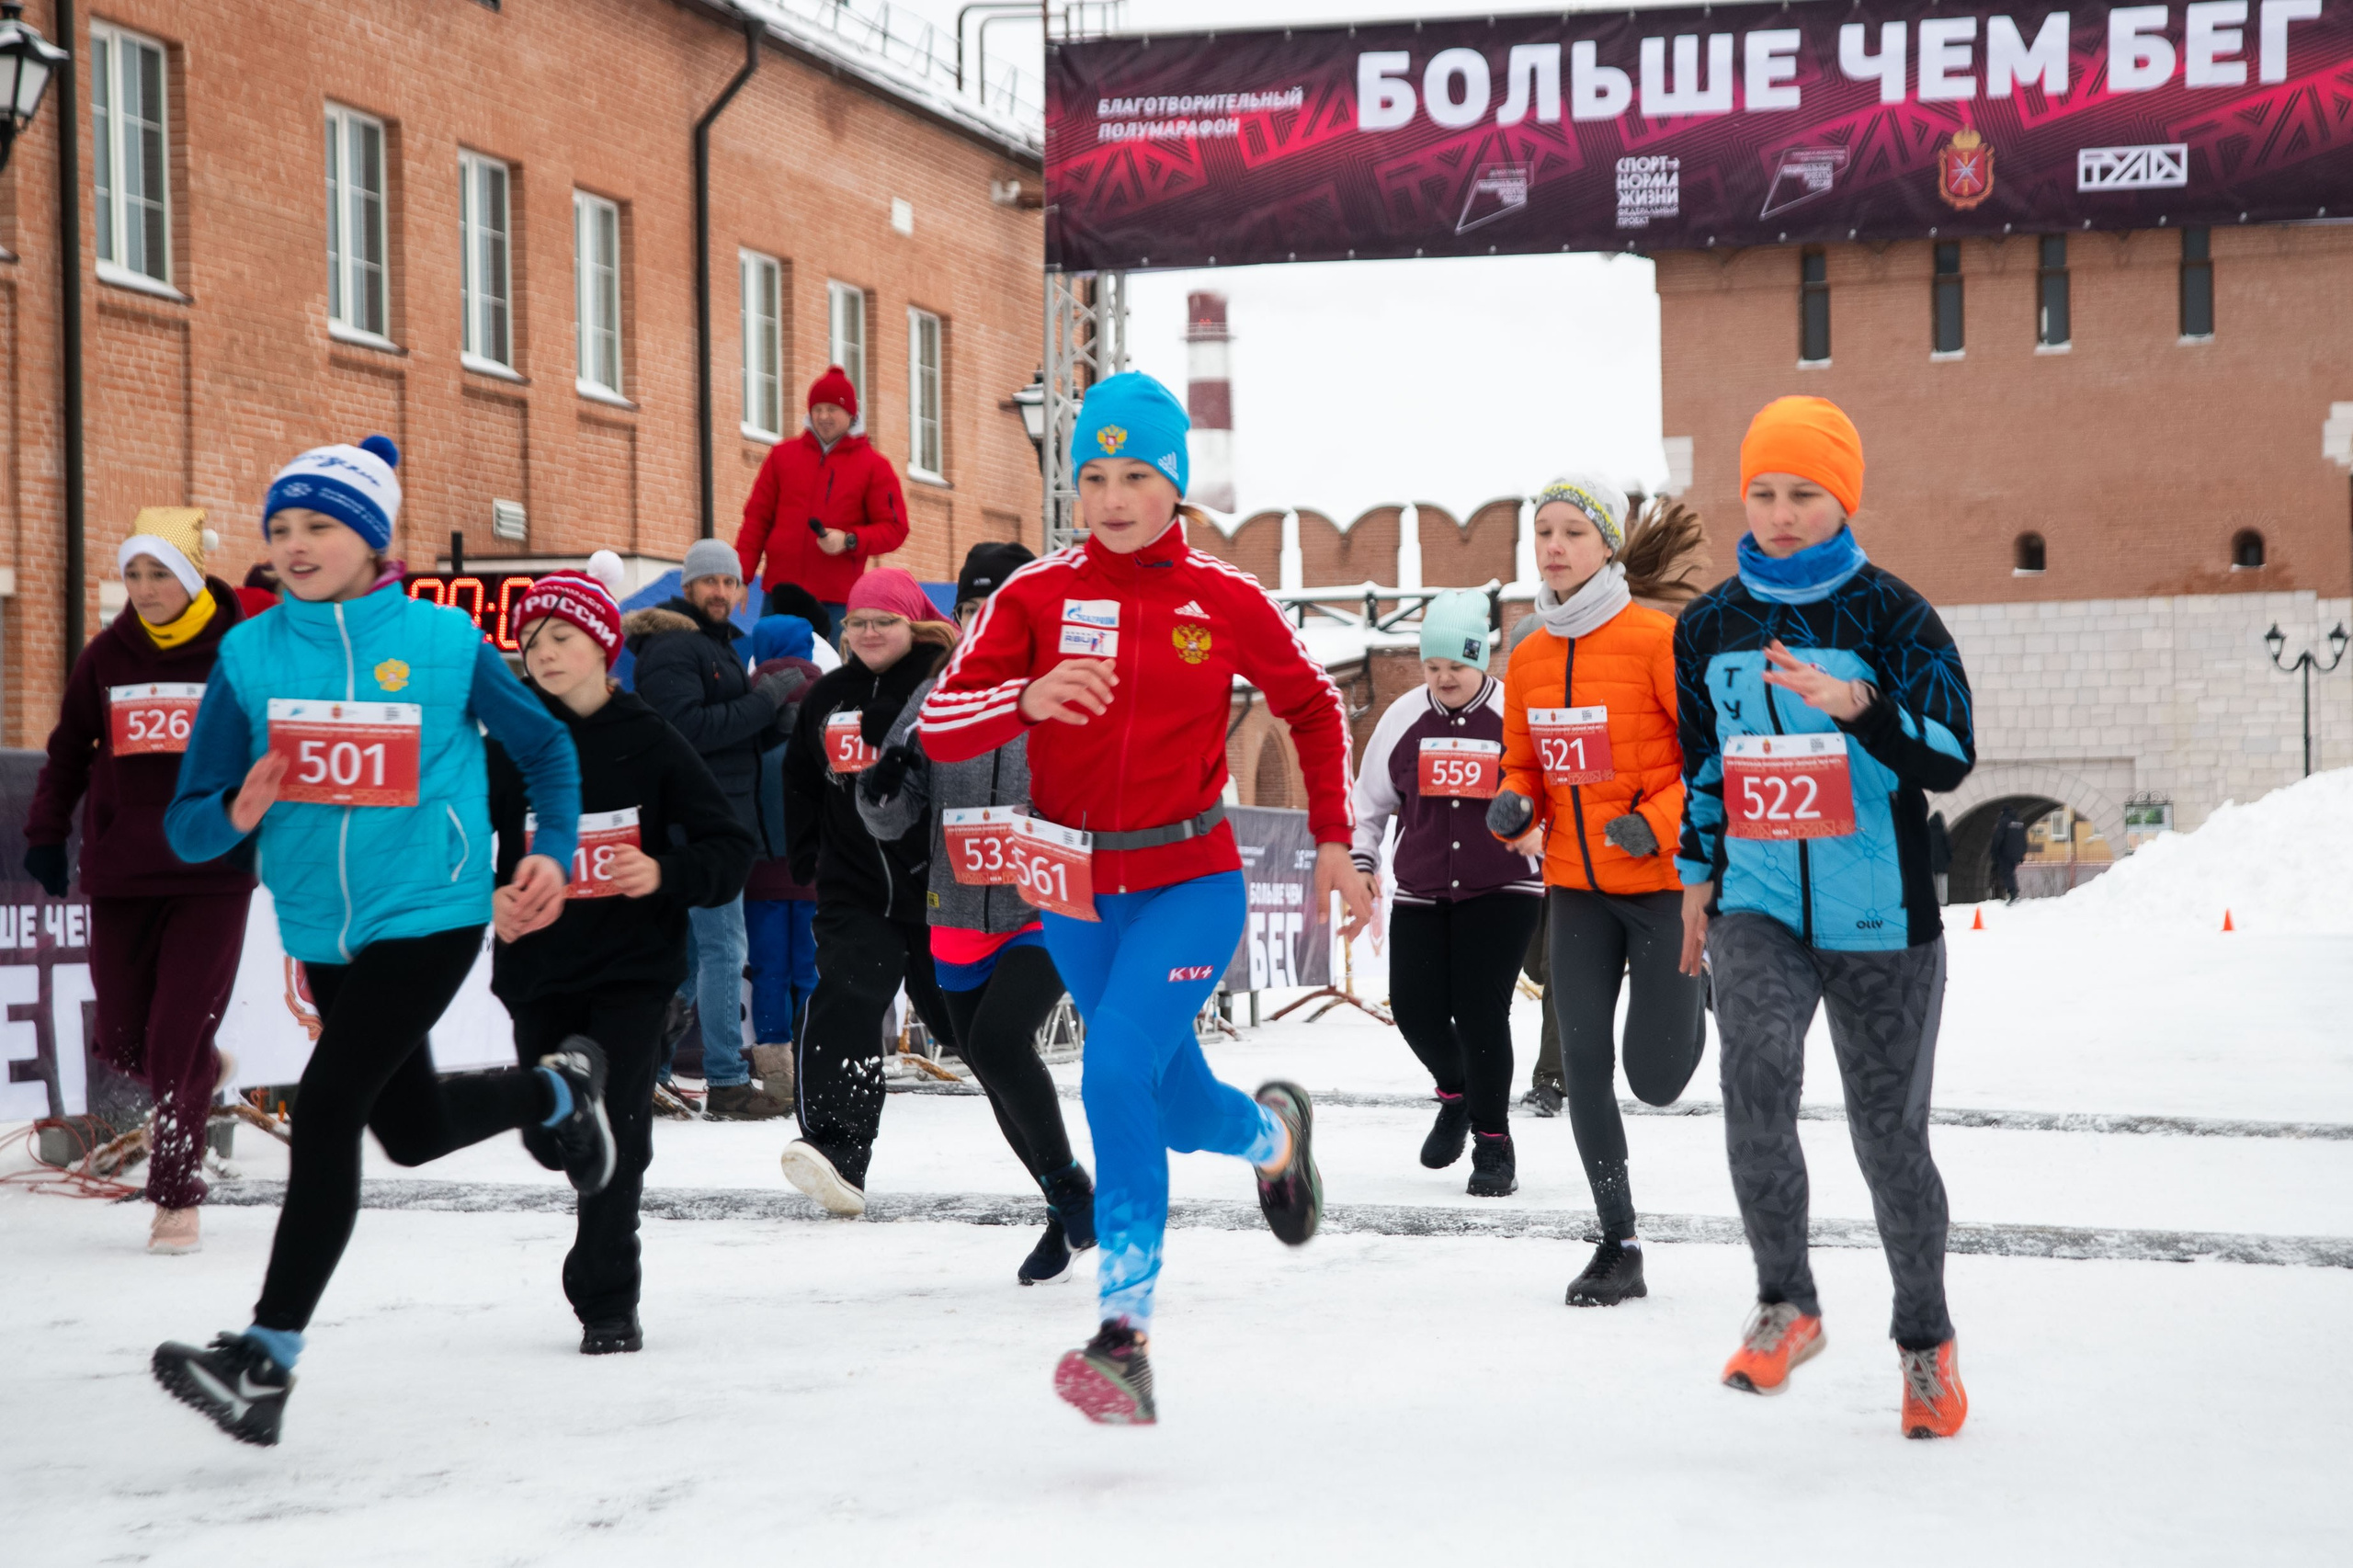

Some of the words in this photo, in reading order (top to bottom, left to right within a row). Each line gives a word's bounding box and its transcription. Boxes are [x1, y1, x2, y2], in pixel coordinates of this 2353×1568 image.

[1358, 29, 1802, 131] БОЛЬШЕ
[1838, 11, 2070, 104] ЧЕМ
[2108, 0, 2323, 94] БЕГ
[1097, 86, 1303, 117] БЛАГОТВОРИТЕЛЬНЫЙ
[1097, 118, 1240, 141] ПОЛУМАРАФОН
[1616, 155, 1668, 173] СПОРТ
[1616, 172, 1679, 189] НОРМА
[1617, 188, 1679, 205] ЖИЗНИ
[525, 593, 618, 648] РОССИИ
[127, 708, 191, 742] 526
[298, 740, 386, 787] 501
[1540, 737, 1586, 771] 521
[1431, 759, 1482, 787] 559
[1743, 775, 1821, 821] 522
[572, 844, 616, 882] 18
[1012, 846, 1069, 903] 561
[1249, 882, 1285, 905] БОЛЬШЕ
[1286, 883, 1304, 905] ЧЕМ
[44, 904, 91, 949] ЧЕ
[1248, 912, 1303, 991] БЕГ
[1167, 965, 1213, 982] KV+
